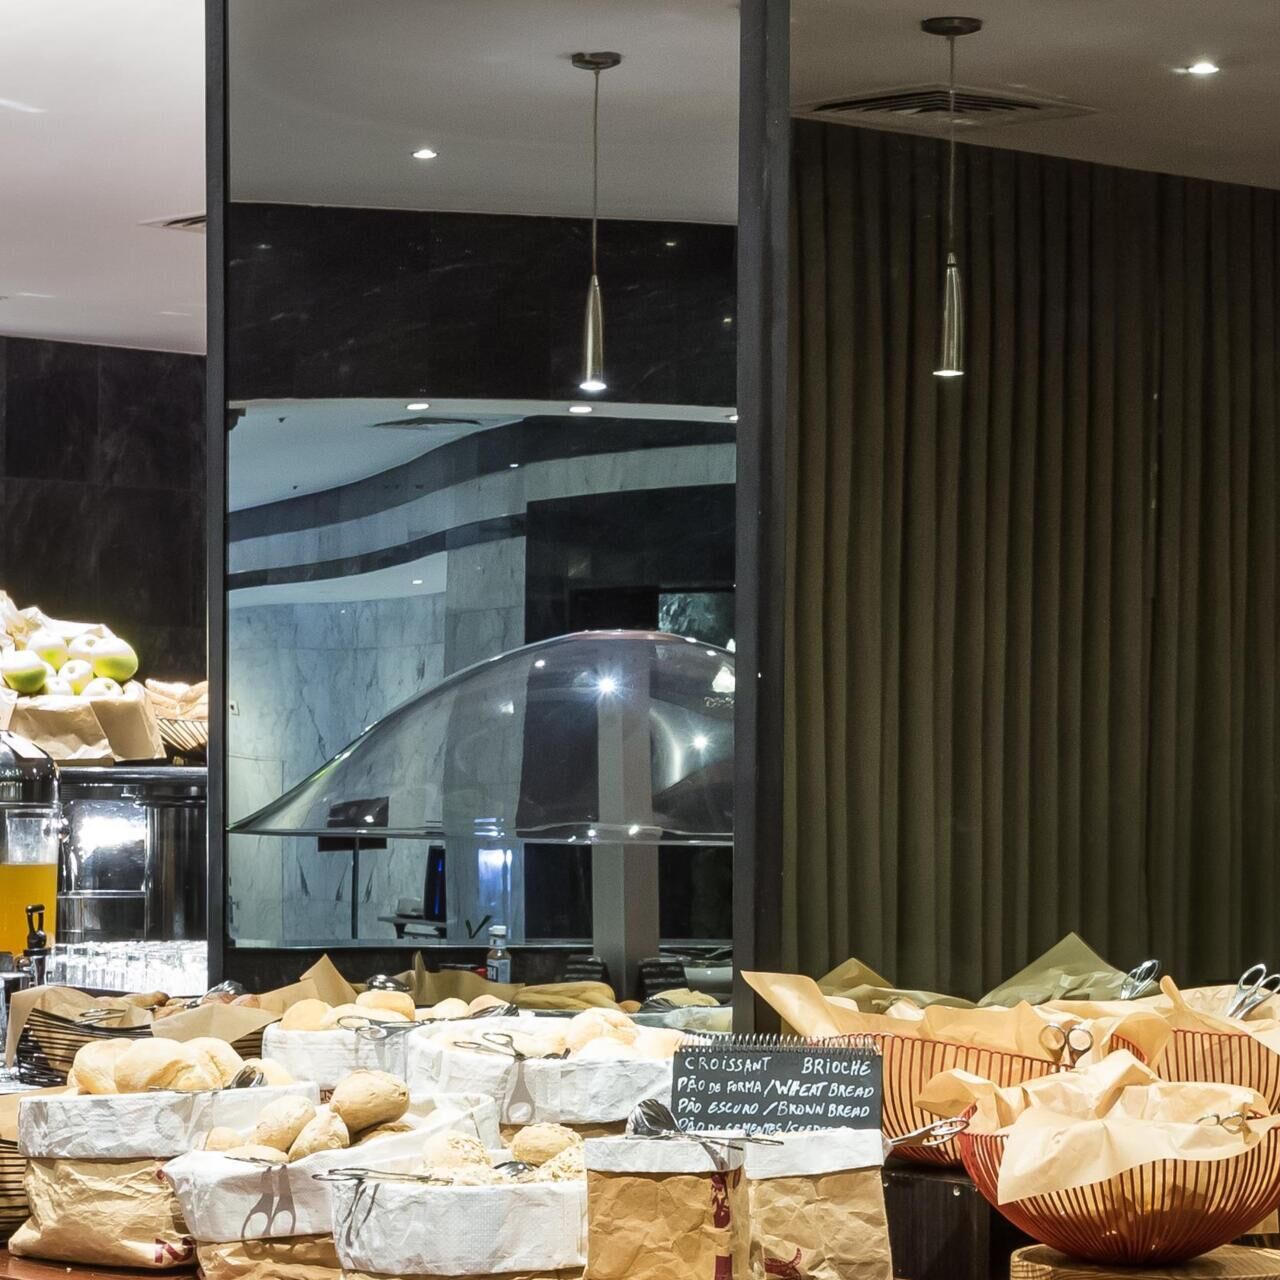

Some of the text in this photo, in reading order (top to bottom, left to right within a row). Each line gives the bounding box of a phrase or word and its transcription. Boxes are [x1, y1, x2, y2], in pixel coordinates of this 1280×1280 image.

[684, 1055, 871, 1075] CROISSANT BRIOCHE
[677, 1075, 706, 1093] PÃO
[708, 1082, 721, 1094] DE
[828, 1082, 874, 1098] BREAD
[678, 1097, 702, 1113] PÃO
[707, 1101, 759, 1115] ESCURO
[827, 1103, 870, 1118] BREAD
